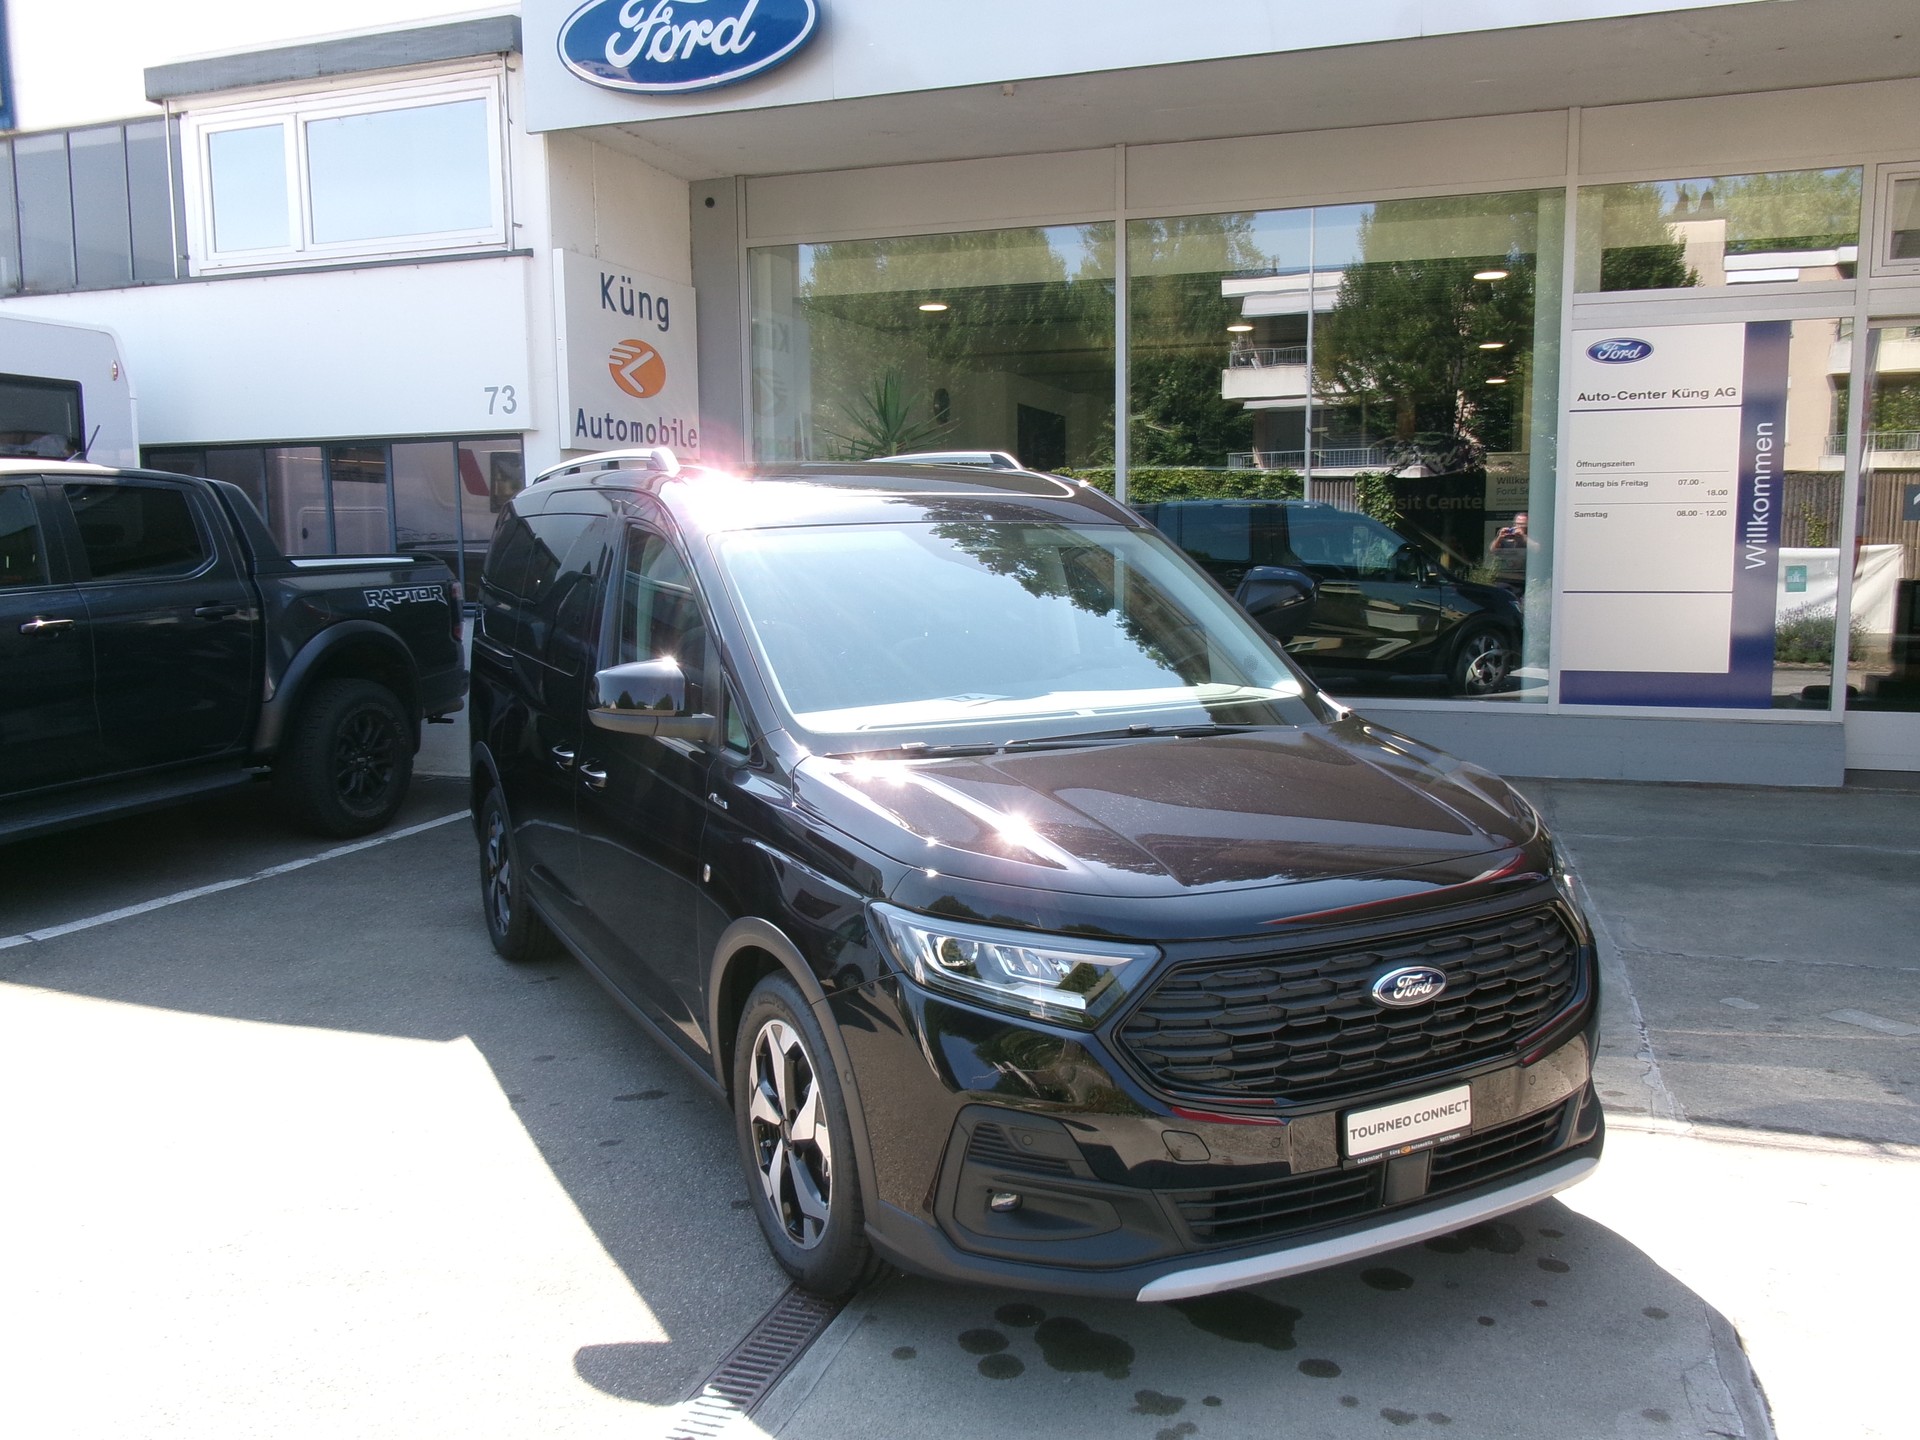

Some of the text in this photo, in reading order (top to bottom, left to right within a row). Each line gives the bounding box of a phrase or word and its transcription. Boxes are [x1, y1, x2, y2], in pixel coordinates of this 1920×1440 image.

[605, 0, 756, 68] Ford
[600, 271, 670, 332] Küng
[1597, 341, 1641, 360] Ford
[484, 384, 518, 415] 73
[1576, 387, 1737, 402] Auto-Center Küng AG
[575, 408, 698, 449] Automobile
[1575, 460, 1635, 469] Öffnungszeiten
[1575, 480, 1605, 488] Montag
[1607, 479, 1619, 487] bis
[1621, 479, 1649, 488] Freitag
[1744, 422, 1774, 570] Willkommen
[1574, 511, 1608, 519] Samstag
[1706, 509, 1727, 517] 12.00
[363, 585, 448, 612] RAPTOR
[1393, 973, 1433, 999] Ford
[1350, 1099, 1469, 1140] TOURNEO CONNECT
